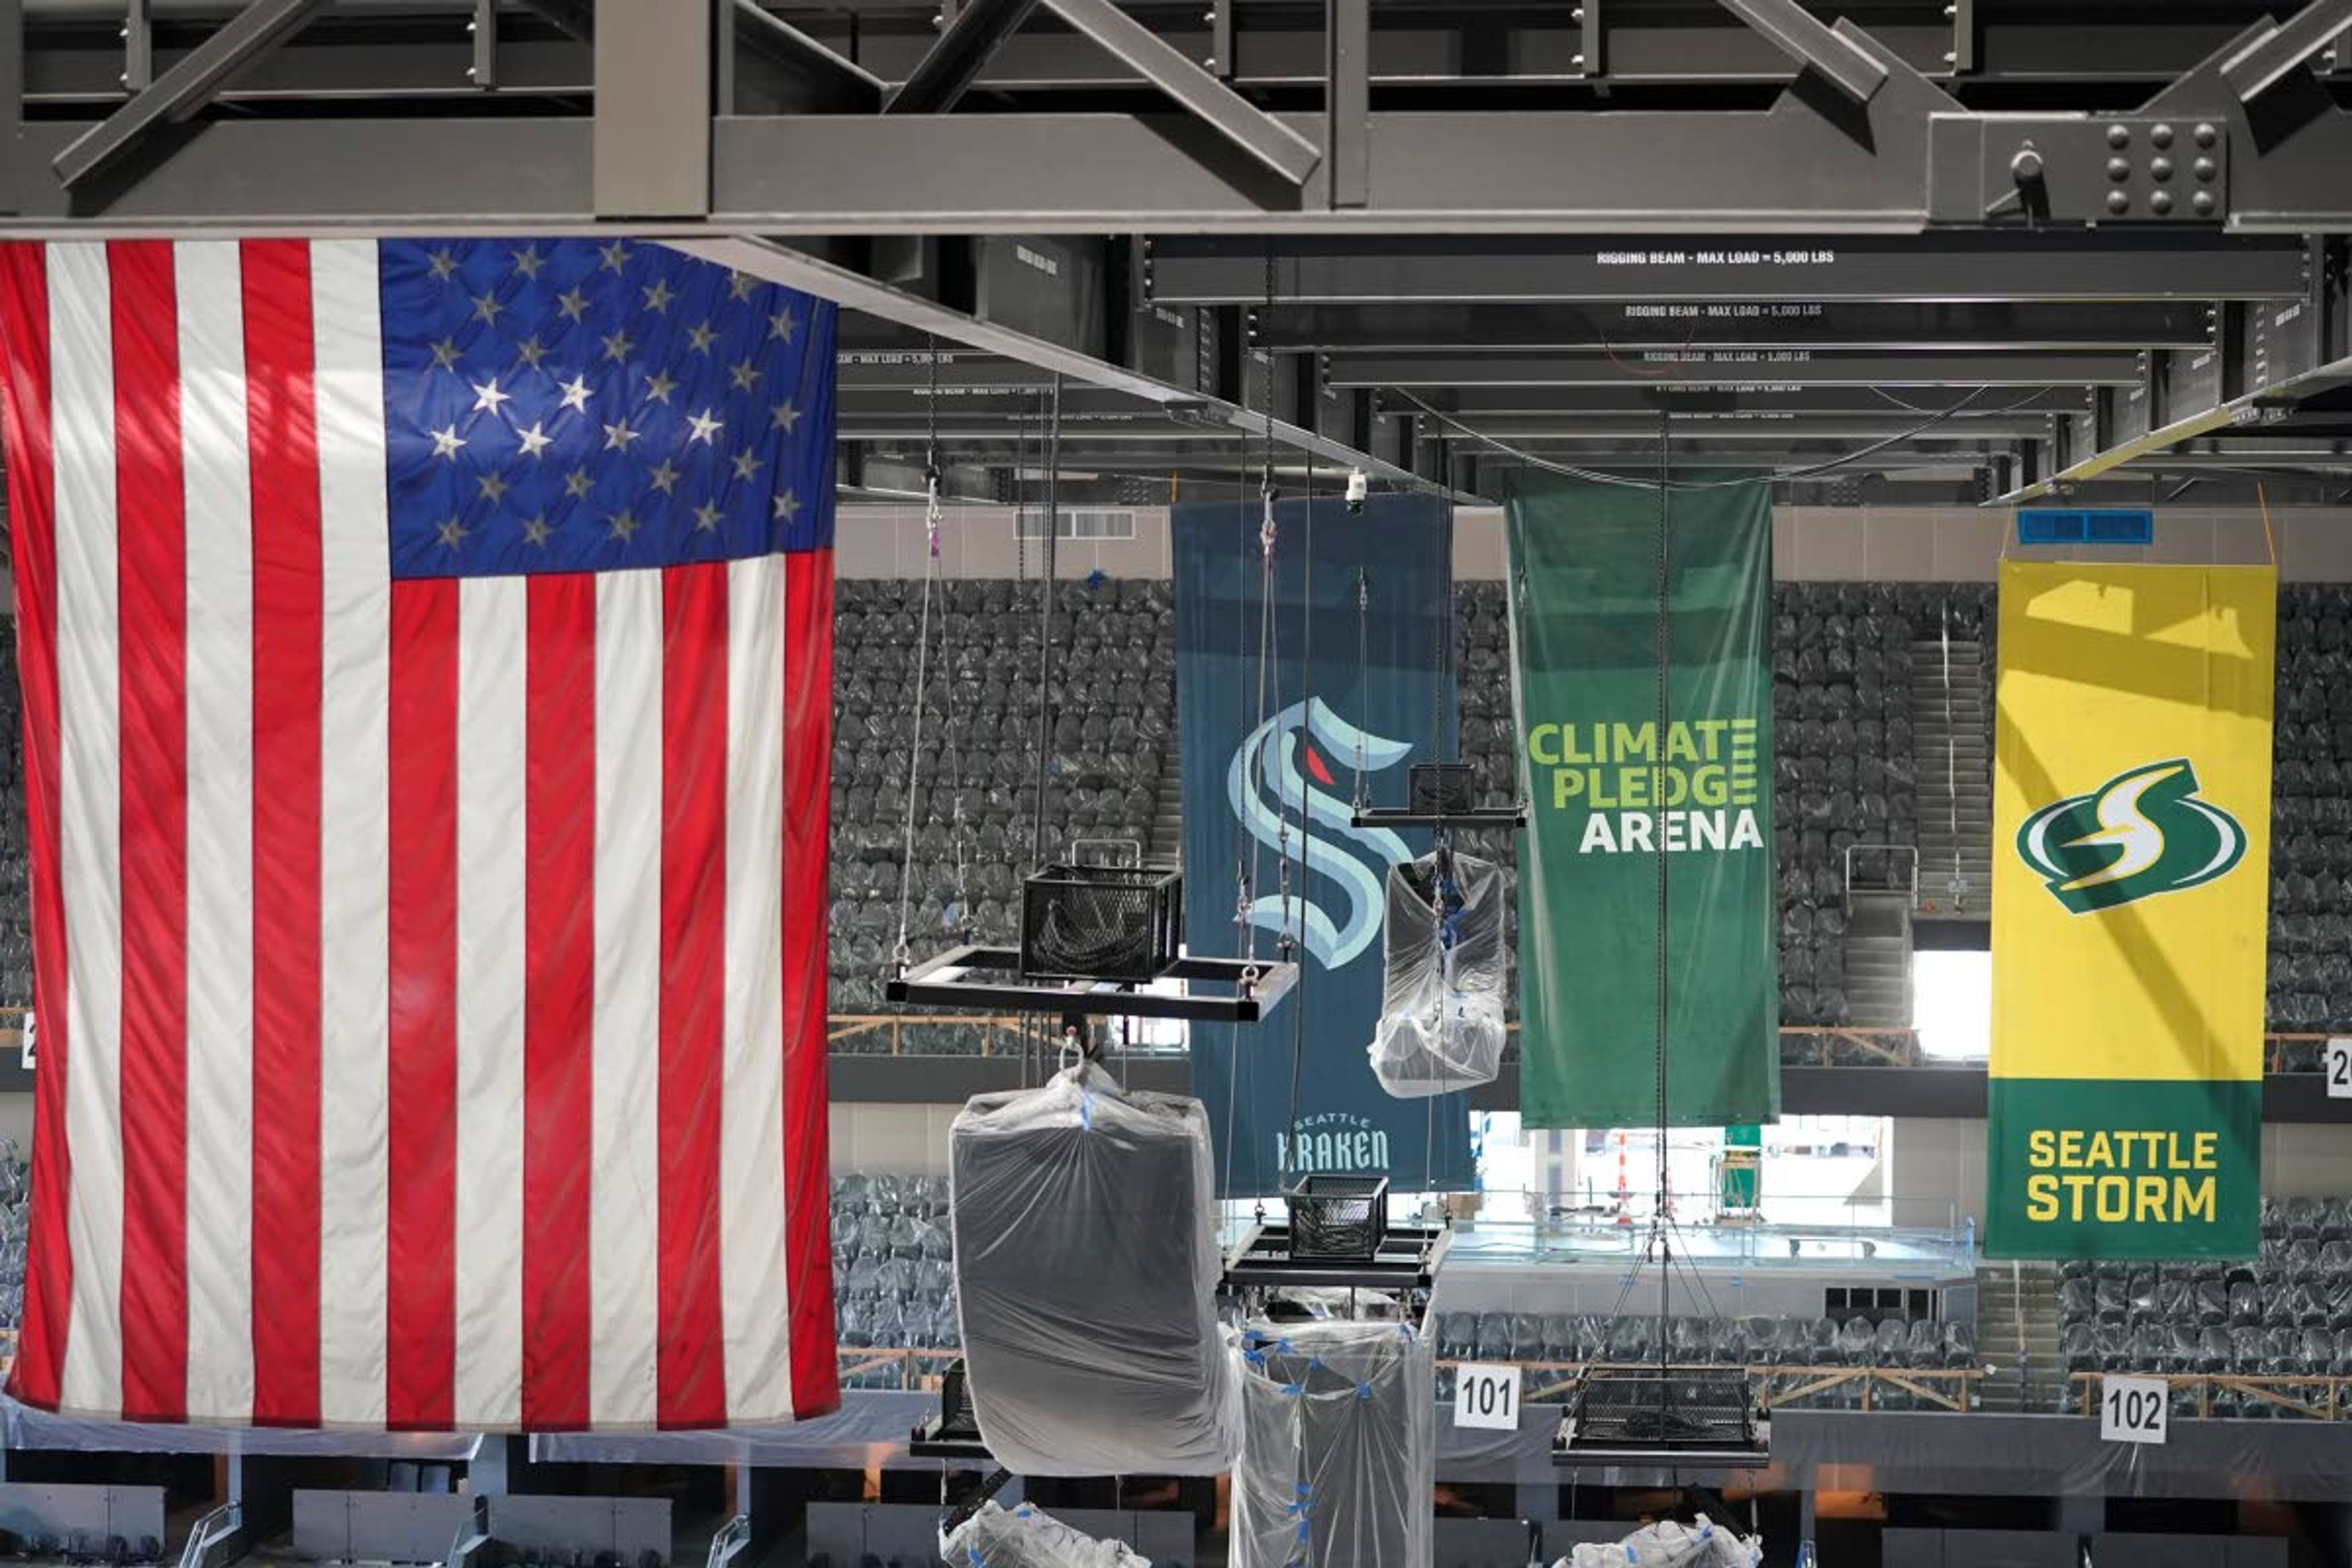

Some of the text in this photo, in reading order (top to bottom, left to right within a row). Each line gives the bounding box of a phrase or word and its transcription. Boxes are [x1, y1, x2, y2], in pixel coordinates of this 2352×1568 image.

[1597, 251, 1647, 264] RIGGING
[1649, 251, 1685, 264] BEAM
[1697, 251, 1725, 264] MAX
[1728, 251, 1760, 264] LOAD
[1773, 251, 1809, 265] 5,000
[1811, 250, 1834, 264] LBS
[1625, 306, 1667, 317] RIGGING
[1669, 306, 1698, 317] BEAM
[1707, 306, 1732, 317] MAX
[1733, 306, 1760, 317] LOAD
[1803, 304, 1823, 316] LBS
[1529, 718, 1757, 765] CLIMATE
[1553, 764, 1757, 809] PLEDGE
[1578, 808, 1765, 854] ARENA
[2333, 1049, 2352, 1085] 2
[1294, 1112, 1371, 1132] SEATTLE
[2029, 1130, 2217, 1169] SEATTLE
[2026, 1174, 2216, 1223] STORM
[1463, 1376, 1510, 1416] 101
[2109, 1389, 2161, 1430] 102
